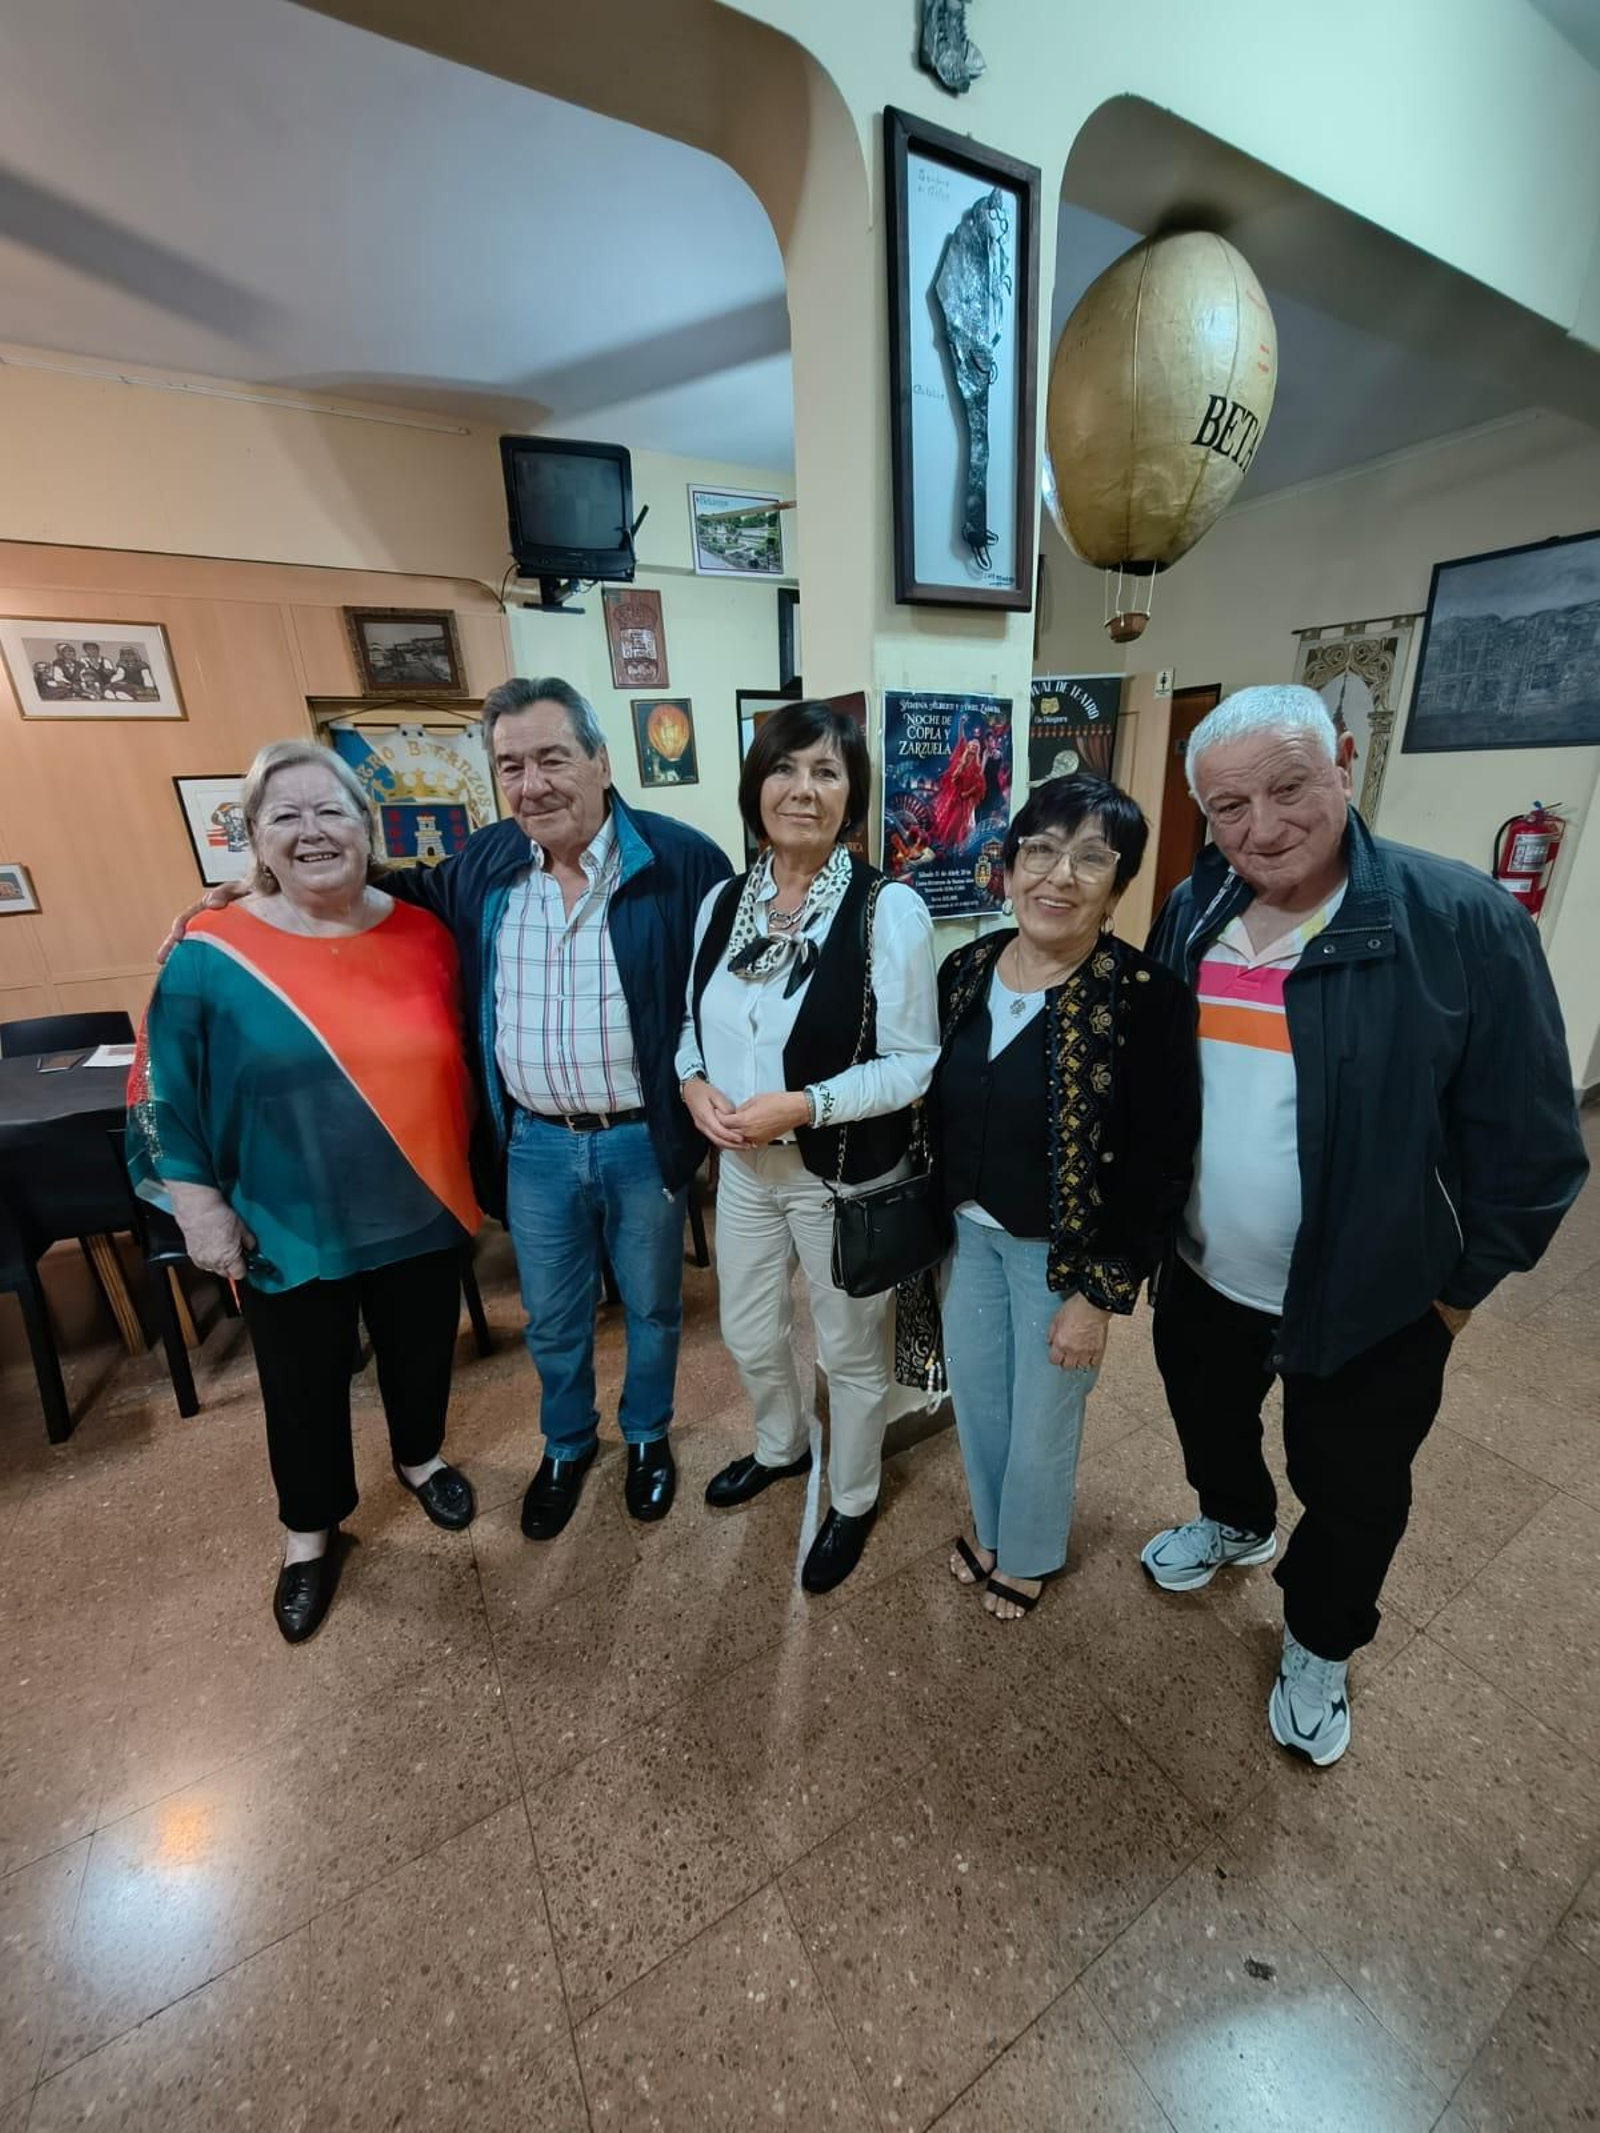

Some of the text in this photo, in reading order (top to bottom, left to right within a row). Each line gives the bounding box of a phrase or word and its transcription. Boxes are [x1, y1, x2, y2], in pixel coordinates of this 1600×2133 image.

[1070, 685, 1100, 720] TEATRO
[903, 713, 952, 726] NOCHE DE
[906, 725, 952, 740] COPLA Y
[899, 740, 952, 759] ZARZUELA
